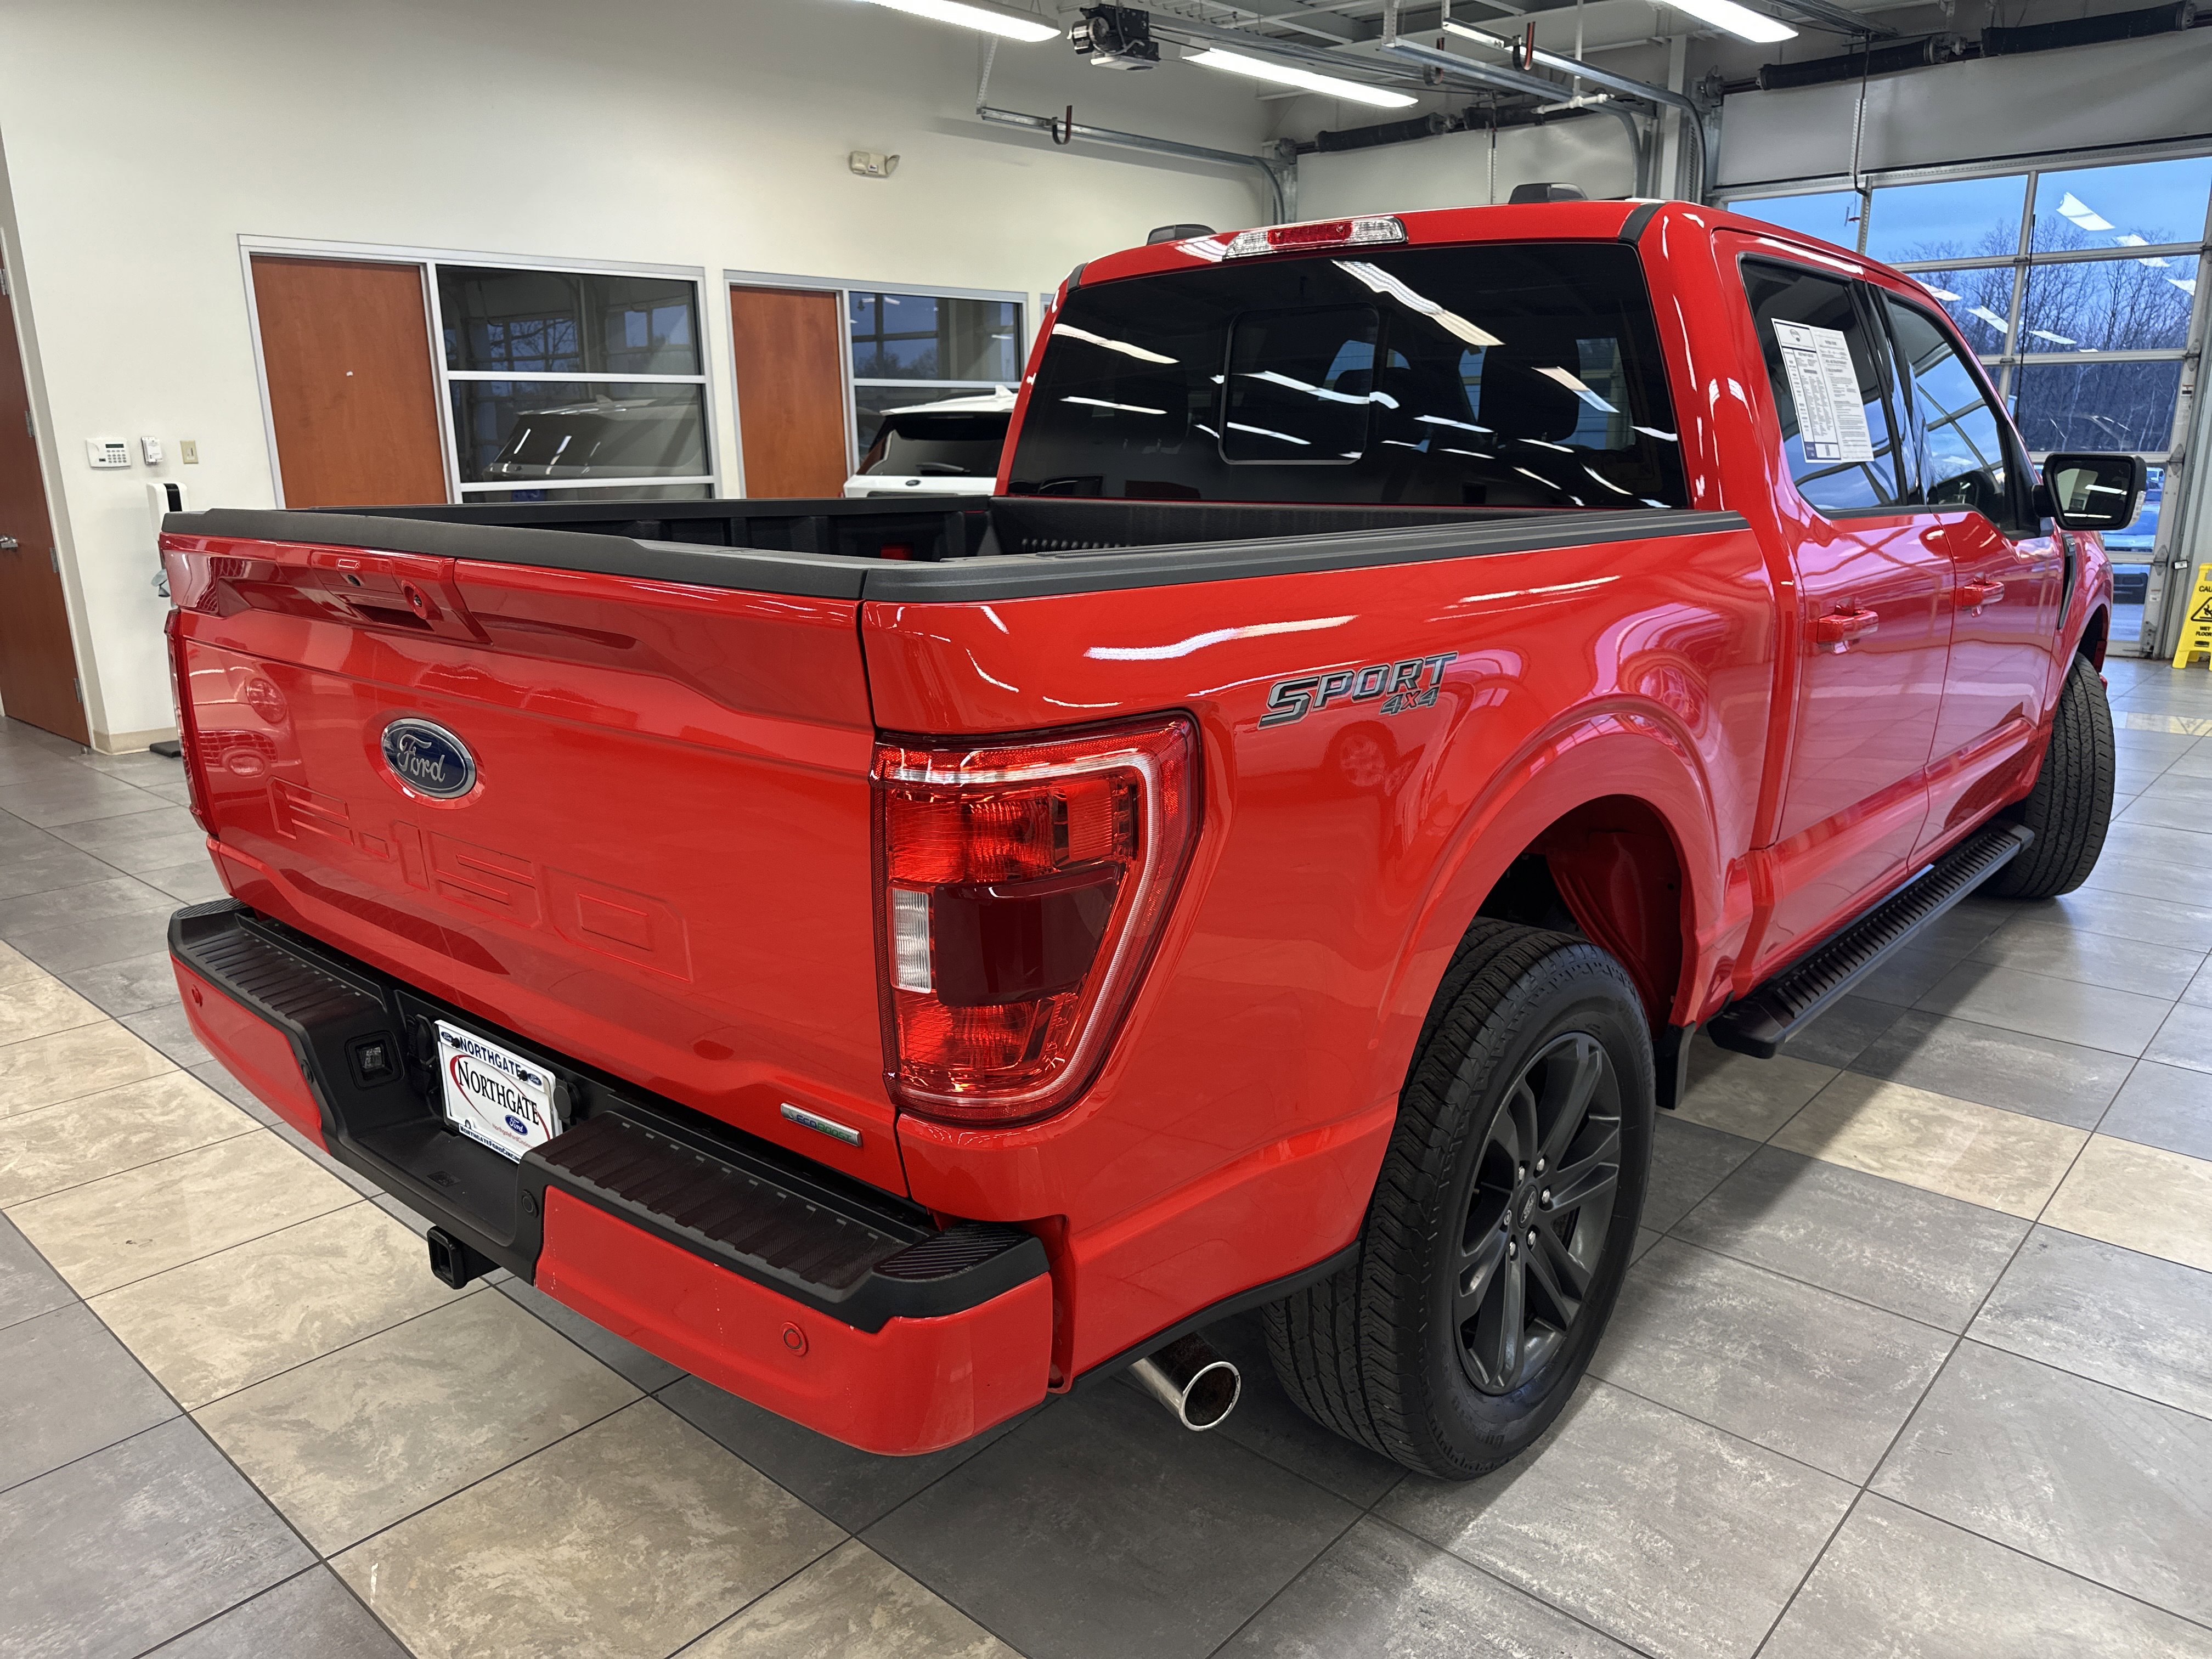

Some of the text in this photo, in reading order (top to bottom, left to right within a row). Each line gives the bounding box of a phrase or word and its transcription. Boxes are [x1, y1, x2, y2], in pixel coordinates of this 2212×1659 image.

[1257, 650, 1459, 730] SPORT
[396, 733, 446, 783] Ford
[266, 776, 693, 983] F-150
[459, 1036, 521, 1077] NORTHGATE
